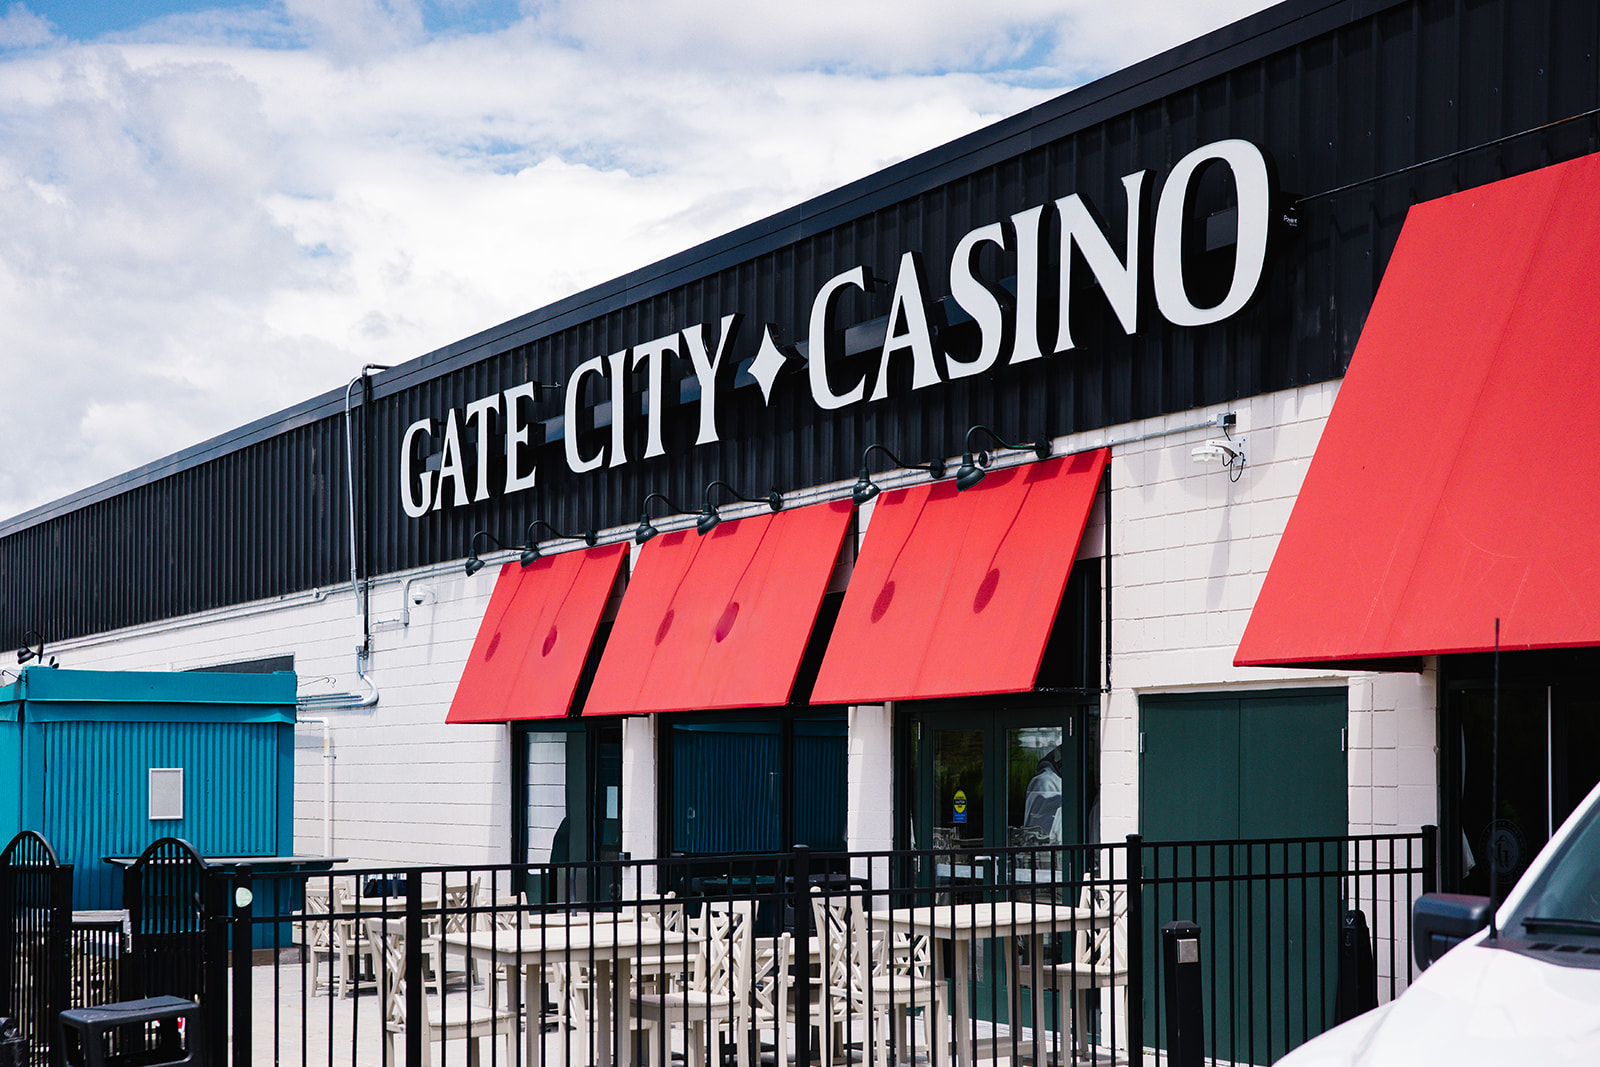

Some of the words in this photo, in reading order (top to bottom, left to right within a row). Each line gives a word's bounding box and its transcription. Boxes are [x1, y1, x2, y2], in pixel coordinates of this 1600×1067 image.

[400, 381, 536, 518] GATE
[564, 313, 735, 474] CITY
[808, 139, 1269, 410] CASINO
